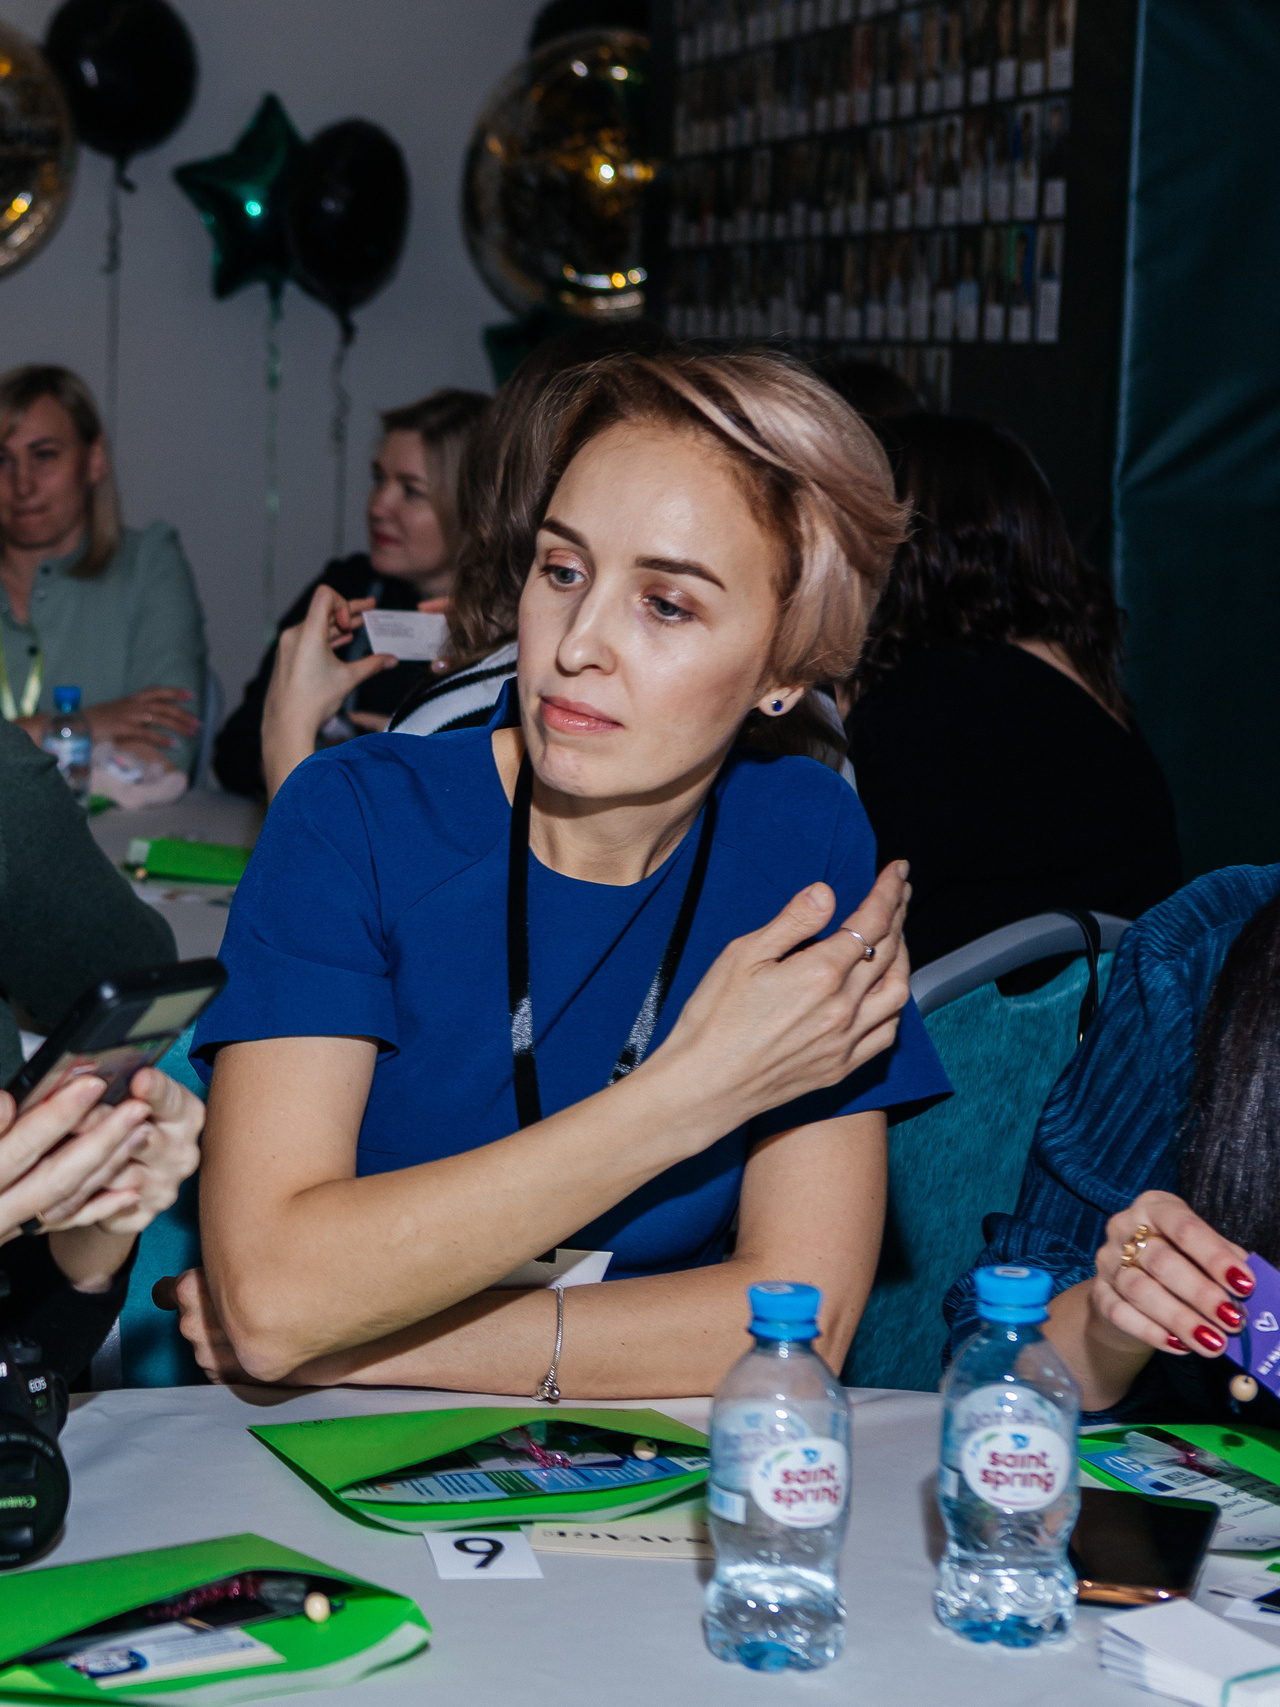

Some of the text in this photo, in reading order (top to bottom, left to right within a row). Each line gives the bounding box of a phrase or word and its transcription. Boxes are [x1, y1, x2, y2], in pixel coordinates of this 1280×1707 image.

[28, 1376, 48, 1393] EOS
[988, 1450, 1050, 1468] saint
[781, 1463, 837, 1485] saint
[980, 1467, 1056, 1494] spring
[772, 1485, 841, 1511] spring
